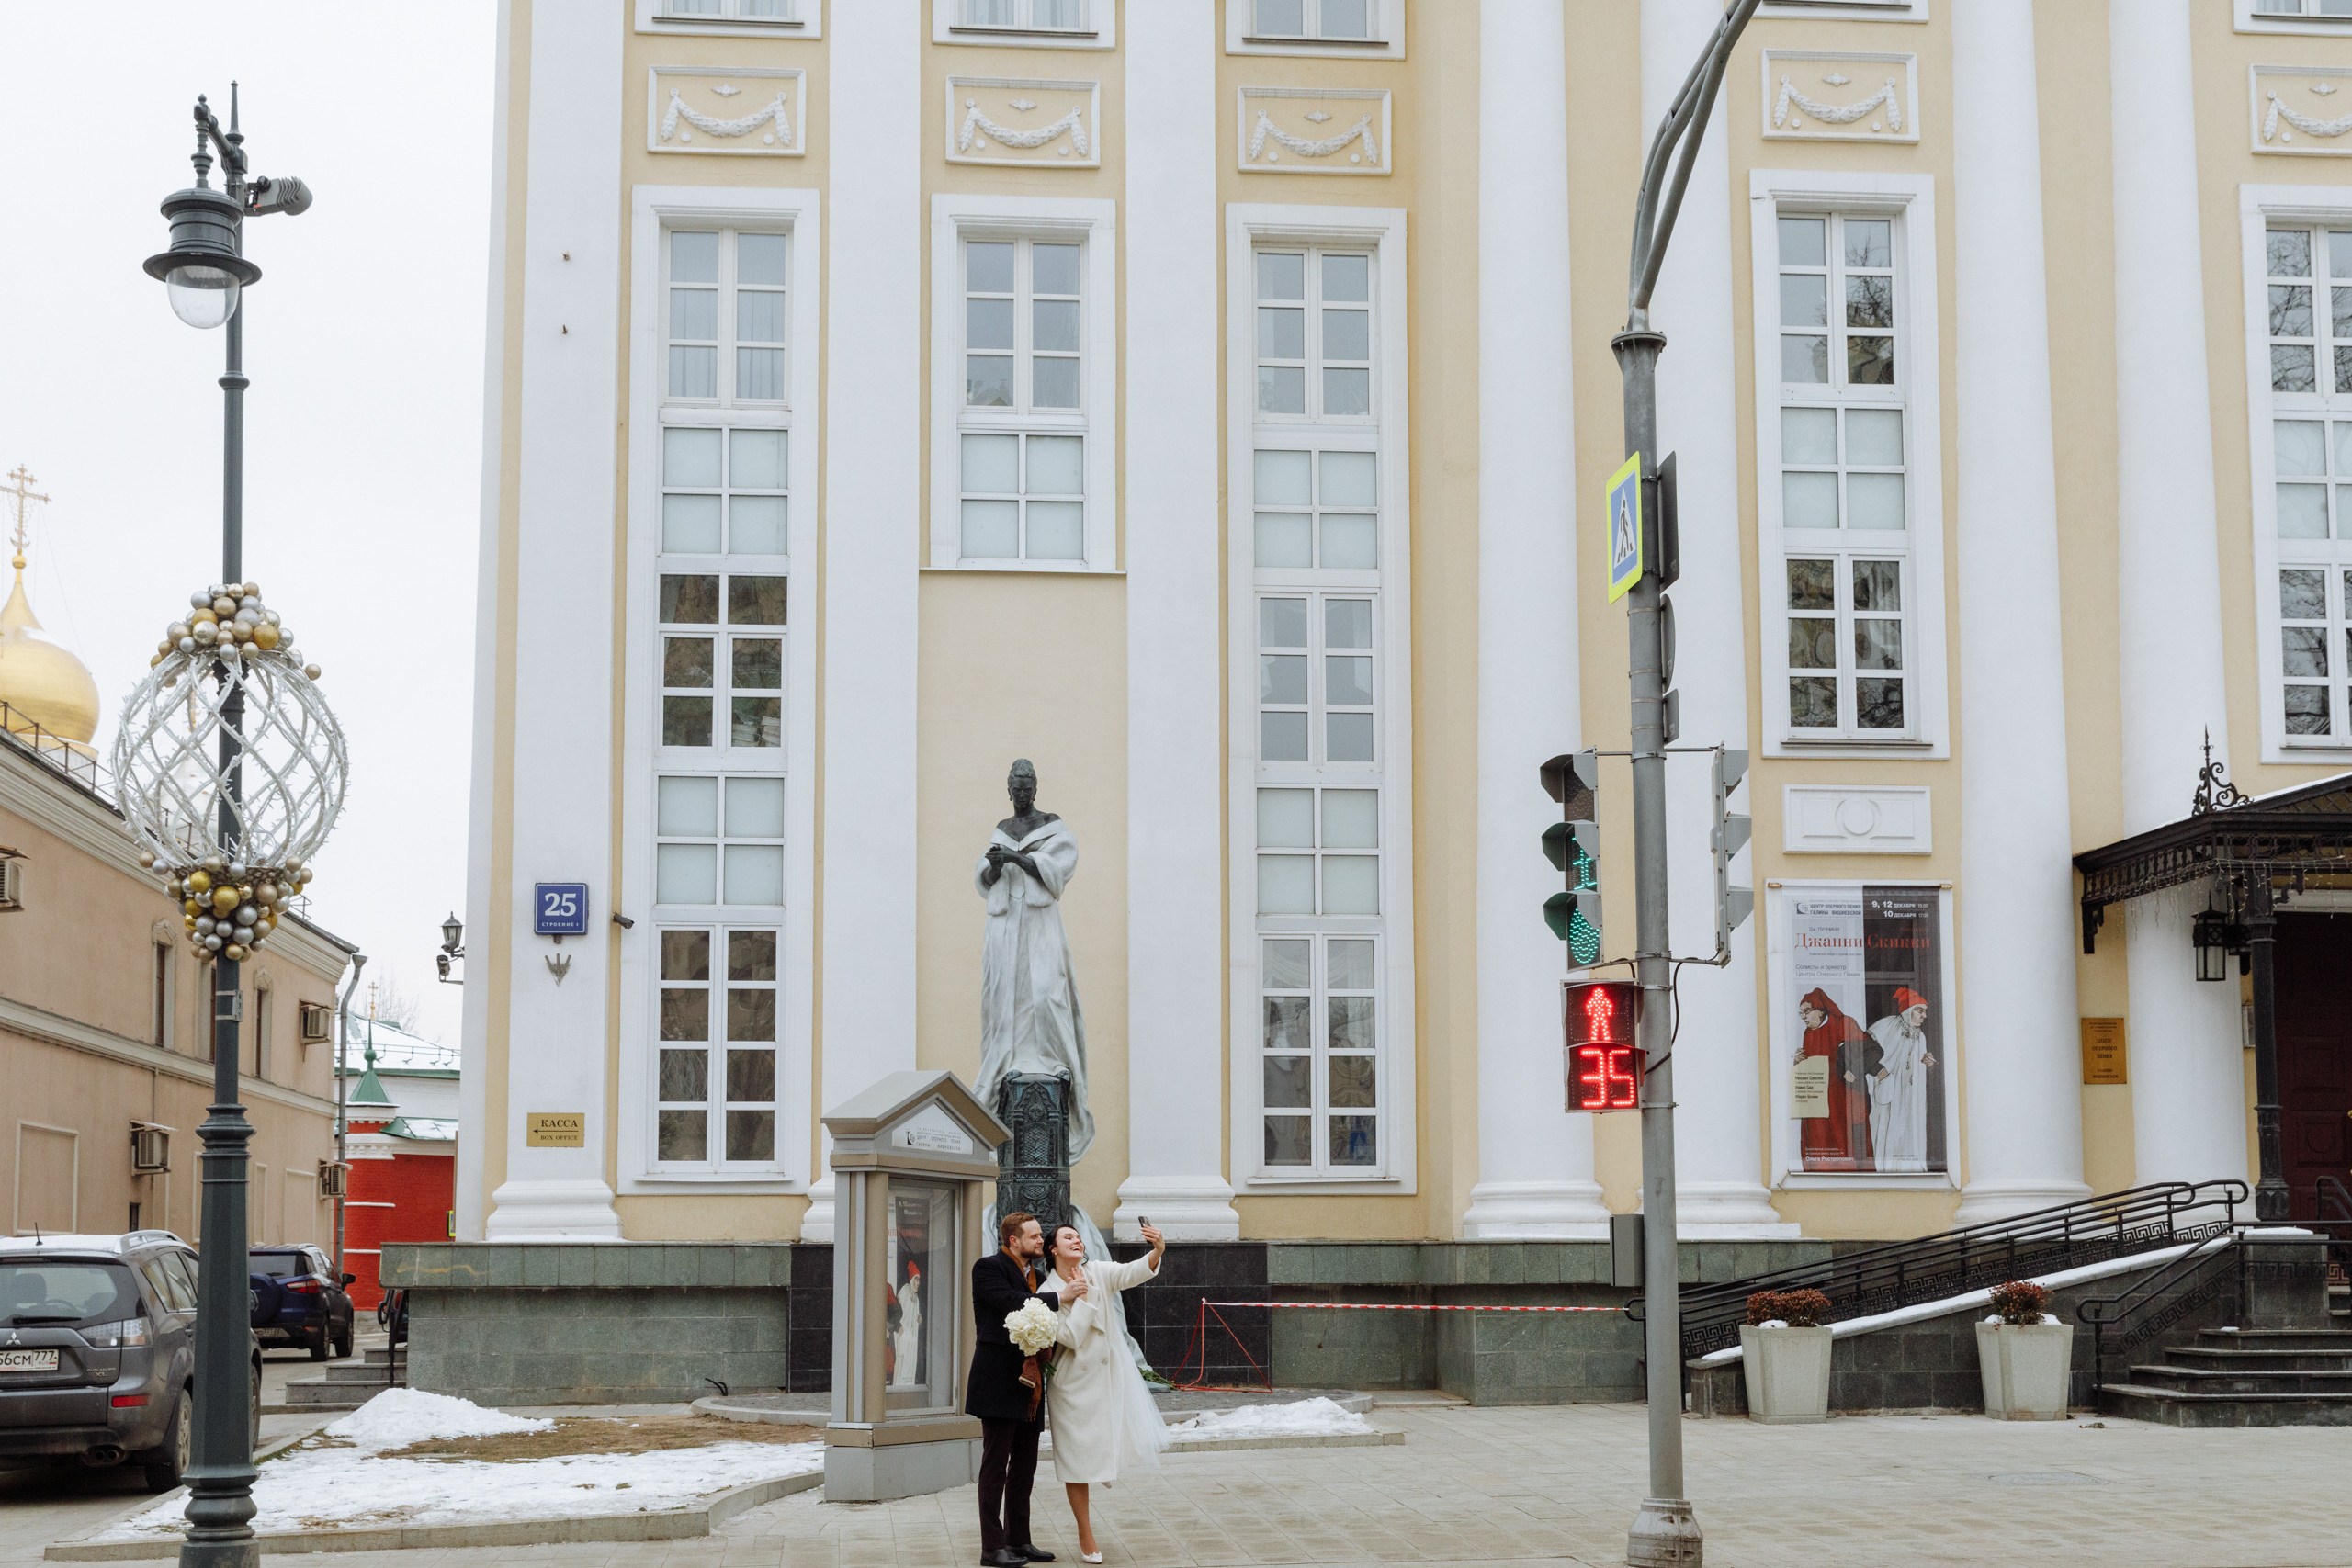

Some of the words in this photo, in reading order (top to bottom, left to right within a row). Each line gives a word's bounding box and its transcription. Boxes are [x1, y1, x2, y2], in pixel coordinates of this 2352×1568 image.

[544, 892, 577, 917] 25
[1871, 900, 1880, 908] 9,
[1794, 933, 1863, 950] Джанни
[1867, 933, 1931, 949] Скикки
[1579, 1047, 1635, 1108] 35
[540, 1119, 578, 1128] КАССА
[34, 1350, 55, 1361] 777
